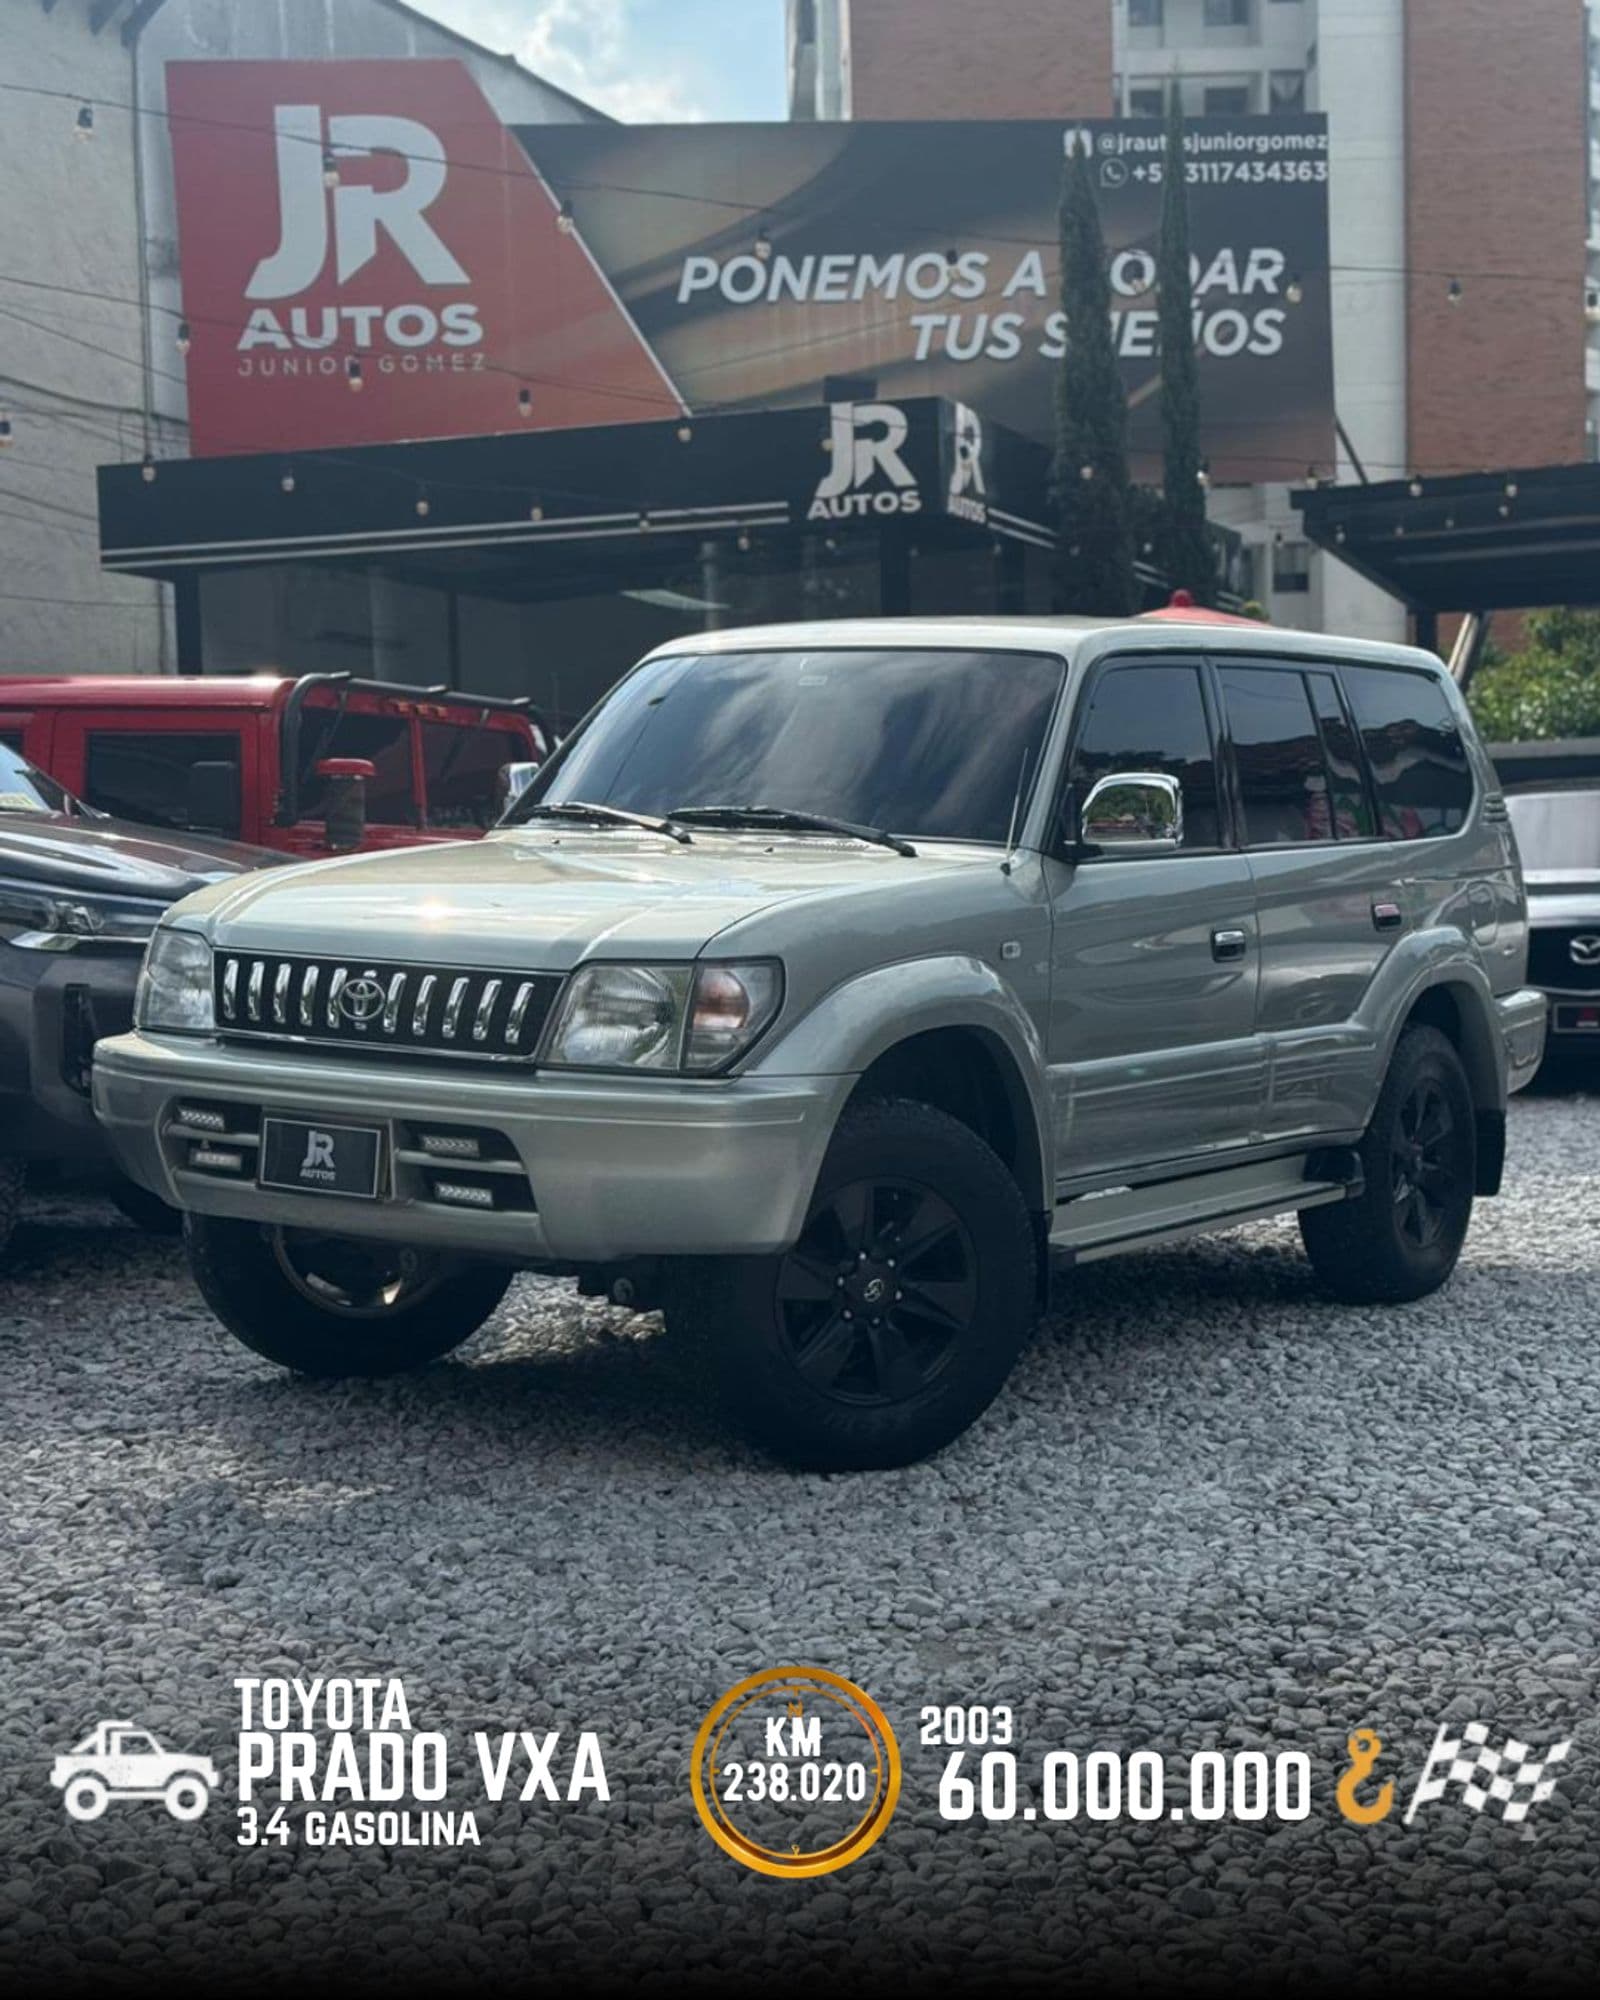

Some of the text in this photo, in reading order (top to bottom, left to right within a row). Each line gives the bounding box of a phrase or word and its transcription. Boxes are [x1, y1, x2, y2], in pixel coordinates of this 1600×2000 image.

[1098, 132, 1328, 154] @jrautsjuniorgomez
[1132, 161, 1328, 183] +5 3117434363
[244, 104, 471, 299] JR
[676, 248, 1285, 304] PONEMOS A OAR
[237, 304, 483, 350] AUTOS
[910, 298, 1287, 361] TUS SEOS
[379, 352, 485, 374] GOMEZ
[815, 402, 918, 499] JR
[807, 490, 922, 520] AUTOS
[302, 1130, 335, 1168] JR
